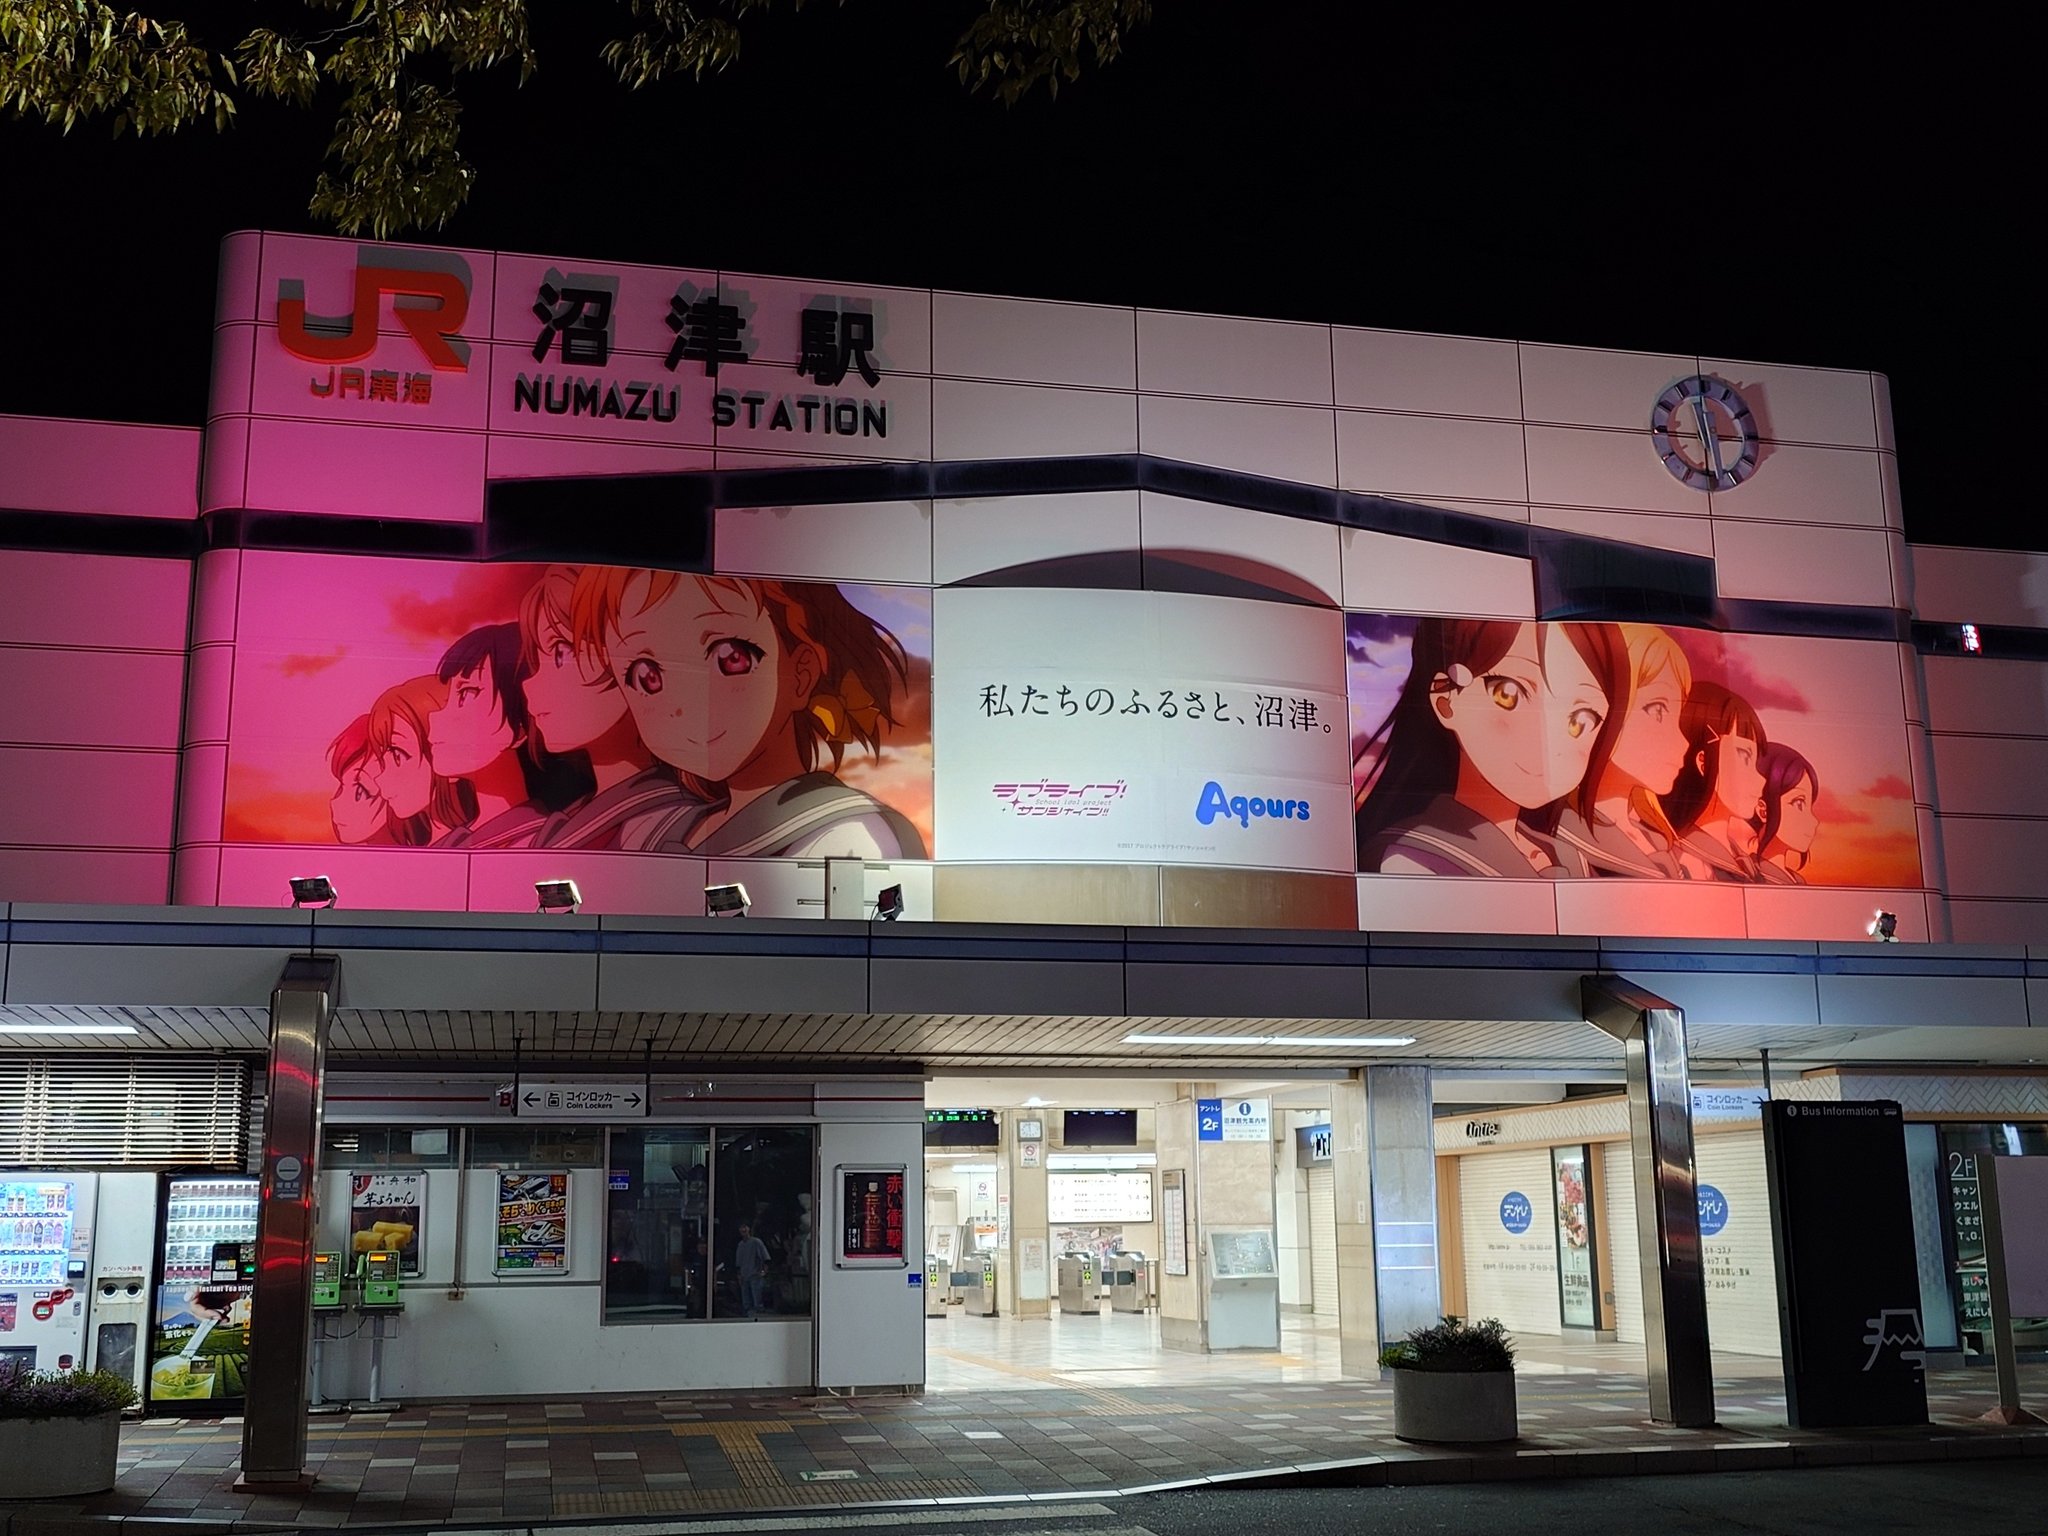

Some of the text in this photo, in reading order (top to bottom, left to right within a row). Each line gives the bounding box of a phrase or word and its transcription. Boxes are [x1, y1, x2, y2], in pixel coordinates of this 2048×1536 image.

[278, 267, 468, 372] JR
[531, 281, 881, 389] 沼津駅
[309, 367, 432, 405] JR東海
[513, 378, 888, 439] NUMAZU STATION
[979, 684, 1332, 734] 私たちのふるさと、沼津。
[1083, 799, 1112, 808] project
[1196, 781, 1310, 828] Aqours
[566, 1091, 621, 1102] コインロッカー
[1706, 1095, 1749, 1104] コインロッカー
[1801, 1106, 1879, 1116] Bus Information
[1202, 1117, 1219, 1131] 2F
[1949, 1152, 1973, 1177] 2F
[363, 1191, 416, 1207] 芋ようかん
